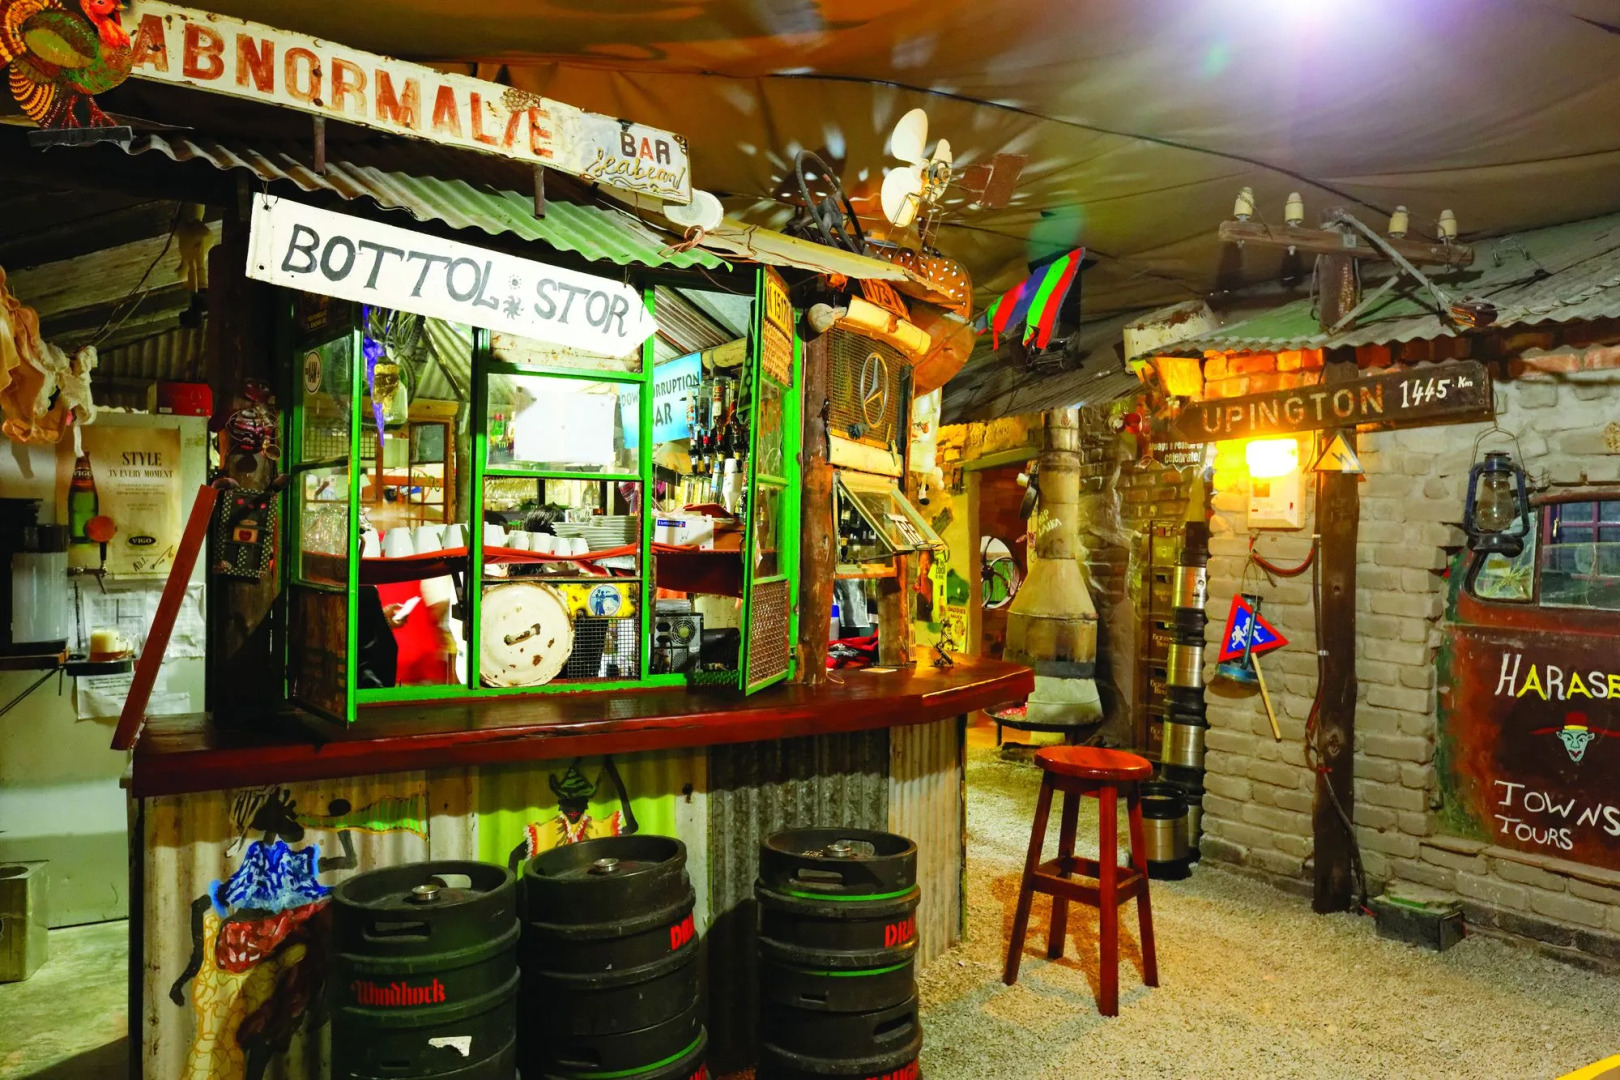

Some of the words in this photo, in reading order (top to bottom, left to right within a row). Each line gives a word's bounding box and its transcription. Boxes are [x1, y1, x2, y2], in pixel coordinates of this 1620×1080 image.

[620, 131, 671, 165] BAR
[281, 223, 500, 306] BOTTOL
[533, 278, 630, 338] STOR
[653, 371, 700, 399] RRUPTION
[654, 402, 673, 427] AR
[1202, 382, 1384, 433] UPINGTON
[1399, 377, 1450, 408] 1445
[1457, 376, 1474, 389] Km
[108, 469, 117, 478] IN
[119, 469, 141, 478] EVERY
[144, 469, 173, 479] MOMENT
[122, 451, 163, 467] STYLE
[1494, 814, 1574, 850] TOURS
